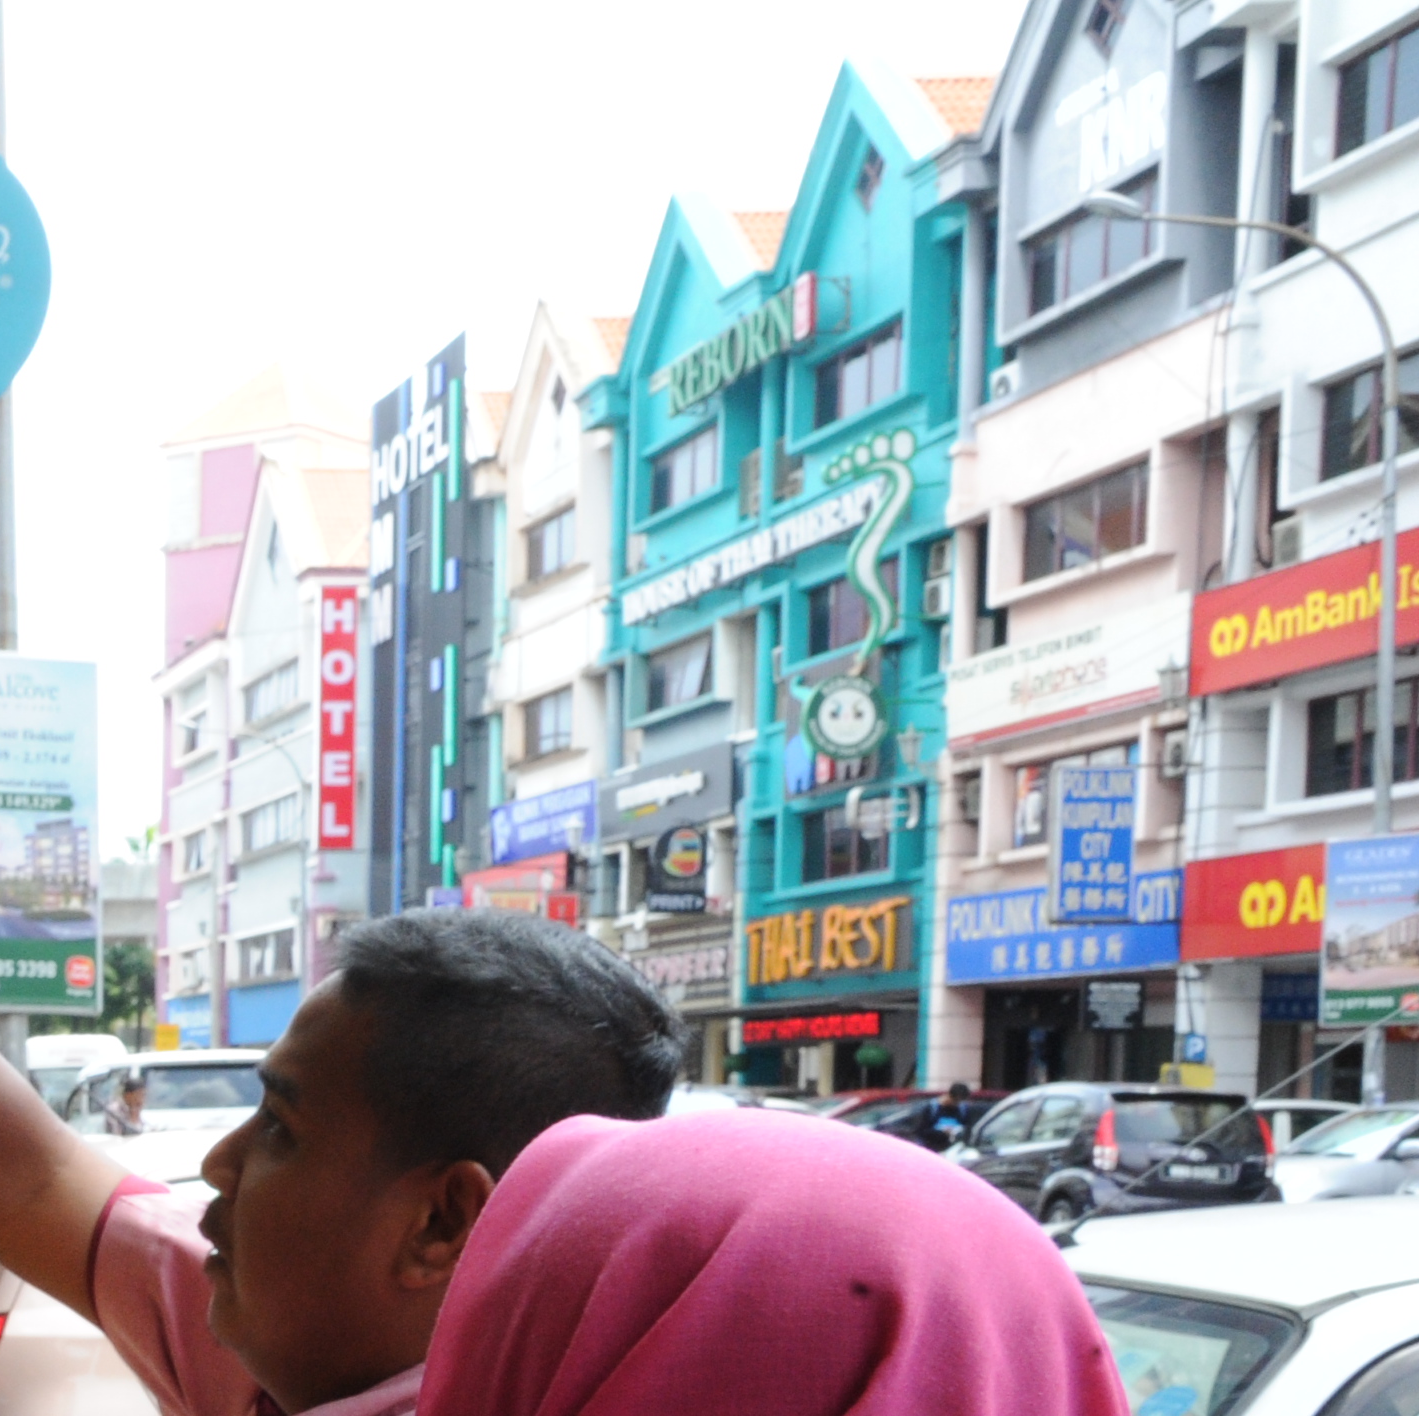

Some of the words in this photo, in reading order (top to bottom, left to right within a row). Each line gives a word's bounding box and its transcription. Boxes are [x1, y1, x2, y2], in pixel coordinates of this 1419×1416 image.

[668, 286, 795, 417] REBORN
[371, 403, 450, 506] HOTEL
[1250, 571, 1383, 649] AmBank
[320, 597, 358, 837] HOTEL
[1080, 831, 1113, 860] CITY
[745, 909, 816, 986] THAI
[819, 895, 914, 973] BEST
[949, 893, 1036, 941] POLIKLINIK
[1136, 875, 1180, 924] CITY
